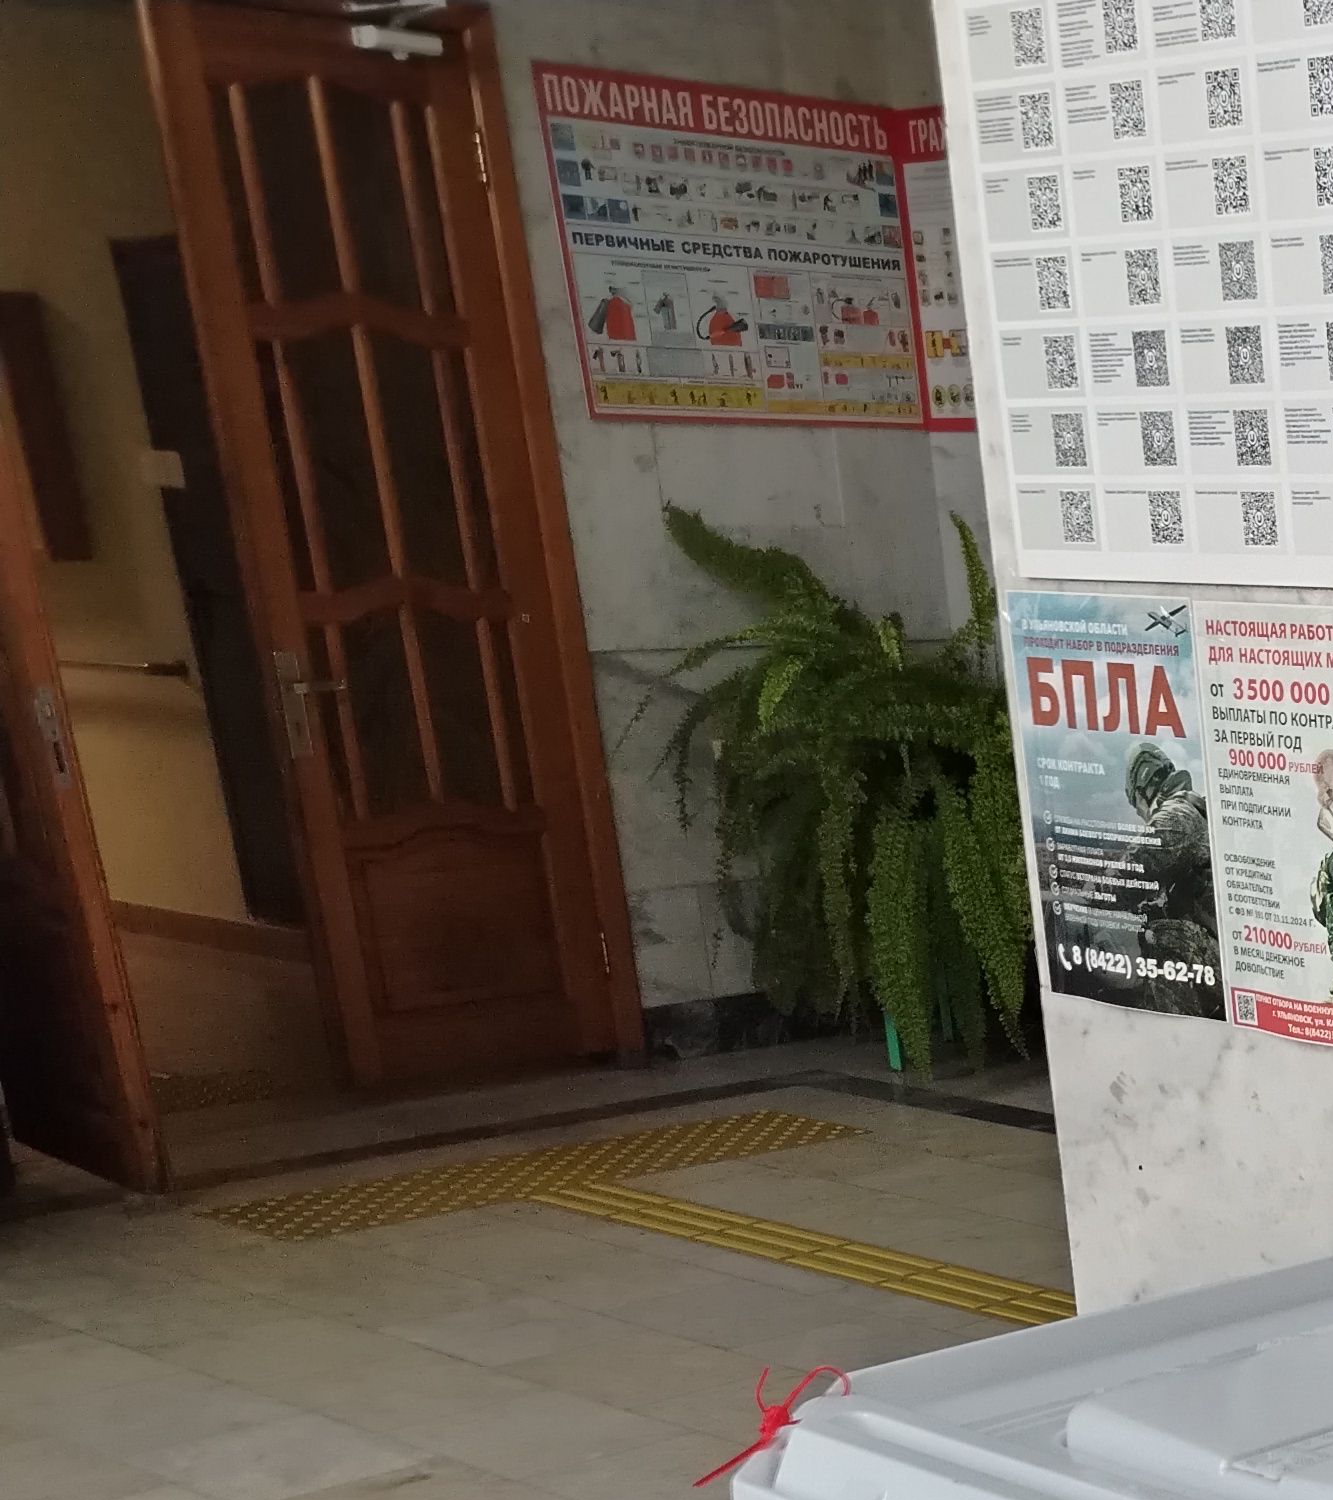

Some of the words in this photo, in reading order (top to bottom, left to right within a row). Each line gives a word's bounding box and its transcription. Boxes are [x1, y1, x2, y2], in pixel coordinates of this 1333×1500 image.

[541, 72, 694, 128] ПОЖАРНАЯ
[701, 94, 888, 151] БЕЗОПАСНОСТЬ
[571, 231, 675, 254] ПЕРВИЧНЫЕ
[681, 240, 763, 261] СРЕДСТВА
[767, 248, 901, 271] ПОЖАРОТУШЕНИЯ
[1028, 619, 1087, 634] УЛЬЯНОВСКОЙ
[1088, 622, 1128, 636] ОБЛАСТИ
[1206, 619, 1287, 642] НАСТОЯЩАЯ
[1066, 639, 1094, 651] НАБОР
[1096, 641, 1102, 652] В
[1104, 641, 1179, 657] ПОДРАЗДЕЛЕНИЯ
[1208, 645, 1233, 665] ДЛЯ
[1239, 648, 1323, 670] НАСТОЯЩИХ
[1026, 656, 1187, 738] БПЛА
[1212, 706, 1266, 724] ВЫПЛАТЫ
[1269, 711, 1287, 725] ПО
[1214, 729, 1228, 743] ЗА
[1230, 730, 1275, 748] ПЕРВЫЙ
[1278, 735, 1302, 753] ГОД
[1037, 757, 1057, 769] СРОК
[1058, 759, 1106, 776] КОНТРАКТА
[1229, 748, 1254, 768] 900
[1258, 751, 1286, 771] 000
[1288, 762, 1324, 775] РУБЛЕЙ
[1044, 775, 1060, 790] ГОД
[1218, 768, 1290, 785] ЕДИНОВРЕМЕННАЯ
[1219, 784, 1254, 797] ВЫПЛАТА
[1221, 800, 1237, 811] ПРИ
[1239, 801, 1291, 817] ПОДПИСАНИИ
[1222, 815, 1263, 830] КОНТРАКТА
[1224, 853, 1276, 869] ОСВОБОЖДЕНИЕ
[1225, 867, 1234, 875] ОТ
[1236, 868, 1272, 881] КРЕДИТНЫХ
[1226, 880, 1273, 895] ОБЯЗАТЕЛЬСТВ
[1234, 894, 1280, 909] СООТВЕТСТВИИ
[1235, 907, 1245, 916] ФЗ
[1265, 912, 1272, 921] ОТ
[1232, 930, 1242, 940] ОТ
[1294, 941, 1327, 955] РУБЛЕЙ
[1072, 945, 1082, 965] 8
[1085, 948, 1131, 979] (8422)
[1136, 957, 1215, 986] 35-62-78
[1240, 946, 1265, 961] МЕСЯЦ
[1265, 951, 1305, 968] ДЕНЕЖНОЕ
[1235, 961, 1284, 980] ДОВОЛЬСТВИЕ
[1294, 1002, 1303, 1012] НА
